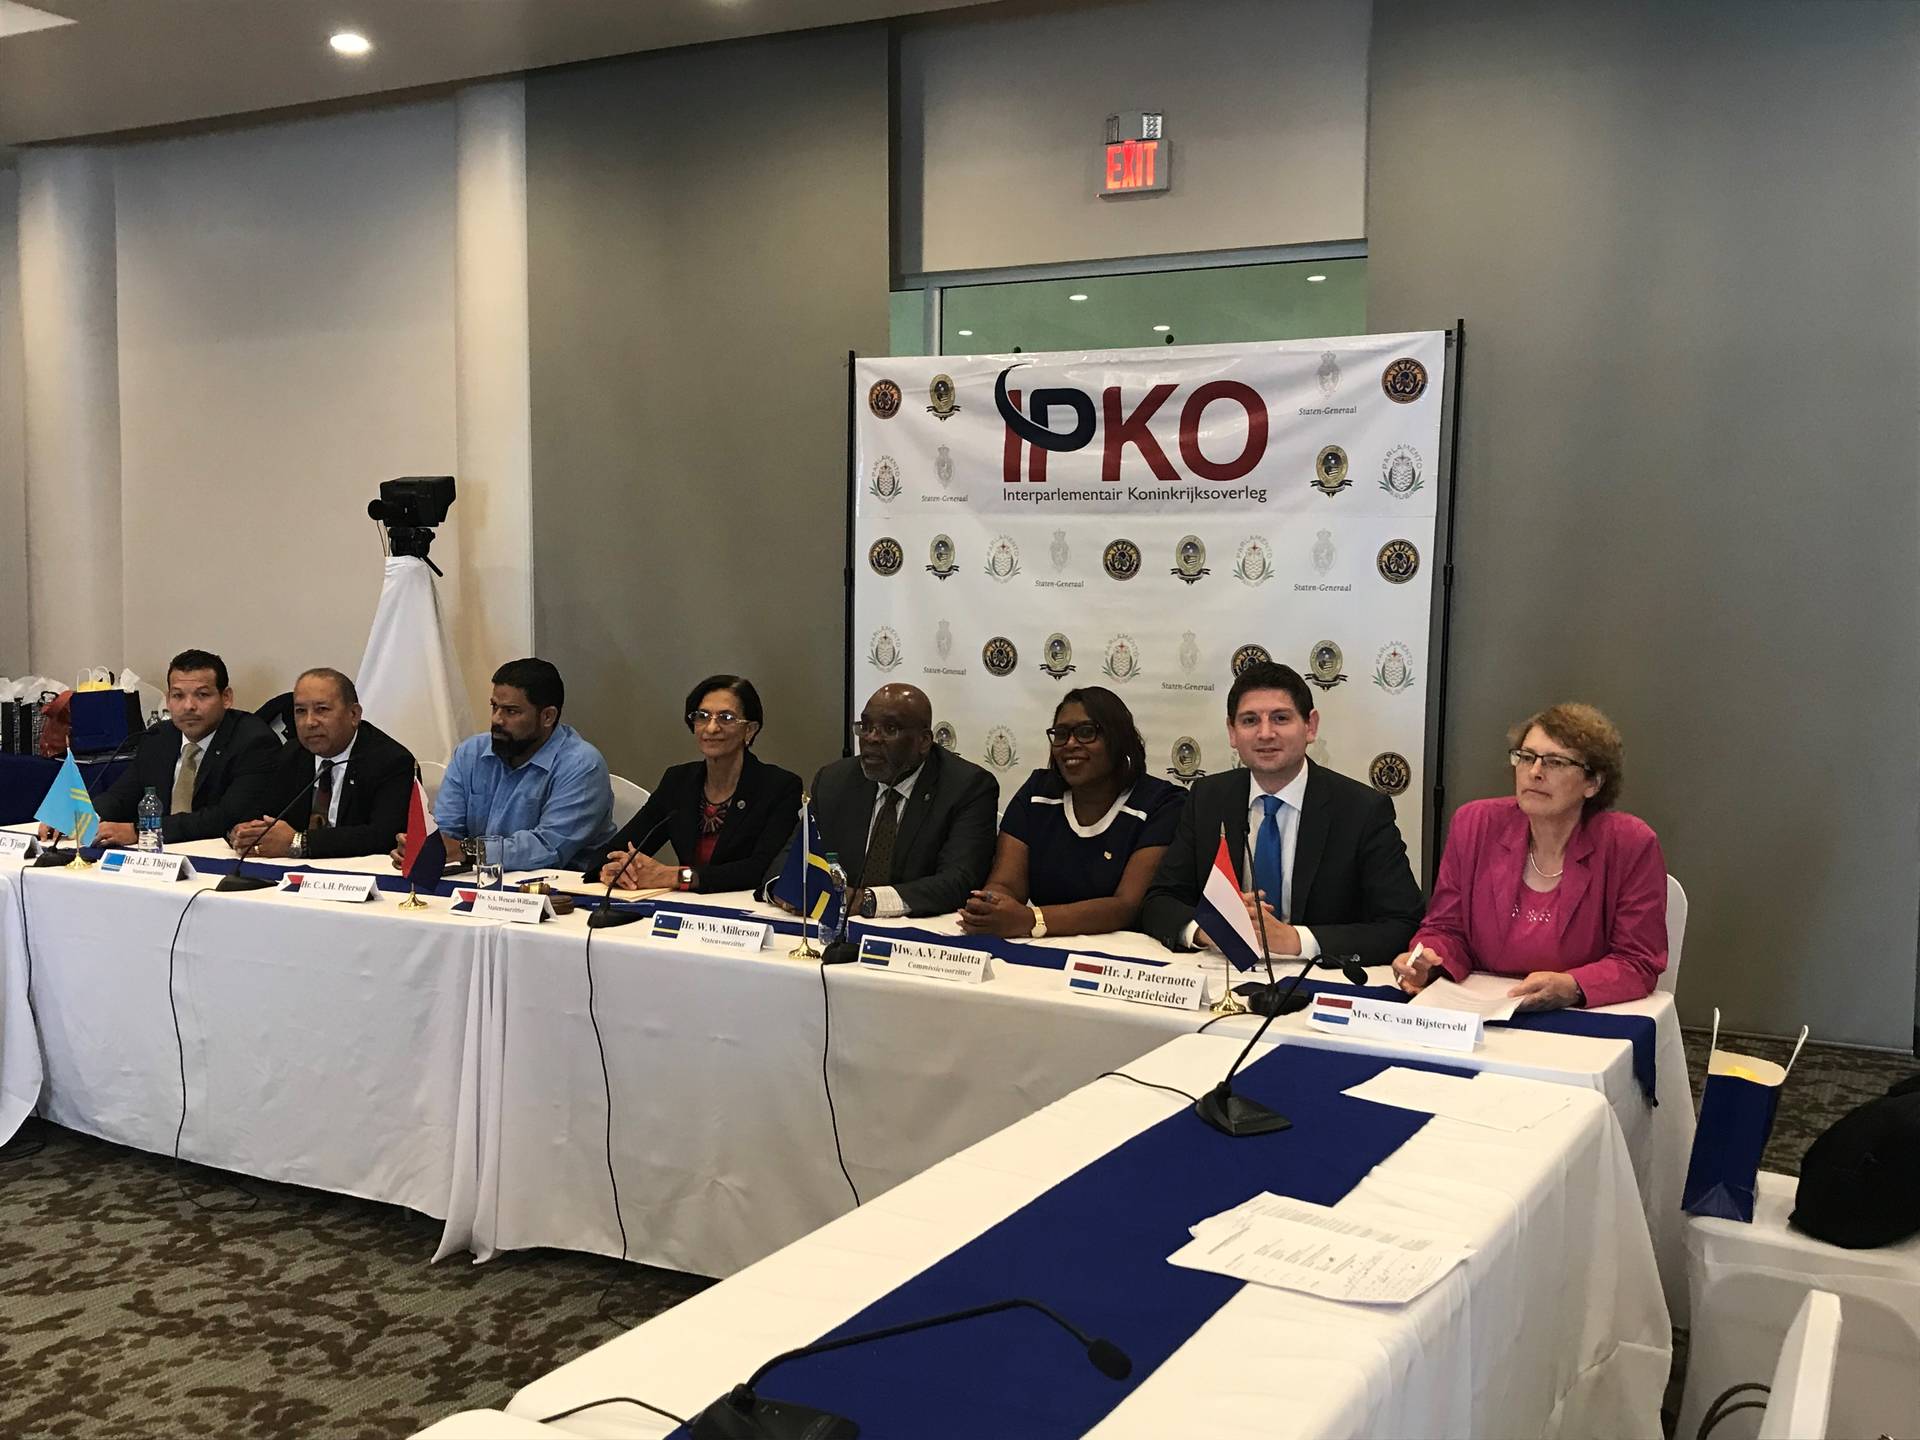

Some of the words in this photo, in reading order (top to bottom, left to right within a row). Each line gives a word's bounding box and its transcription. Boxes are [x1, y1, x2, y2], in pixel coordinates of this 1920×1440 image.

[1105, 141, 1158, 189] EXIT
[1298, 405, 1358, 416] Staten-Generaal
[995, 364, 1269, 482] IPKO
[1003, 487, 1123, 504] Interparlementair
[1128, 485, 1267, 503] Koninkrijksoverleg
[1293, 583, 1352, 592] Staten-Generaal
[1161, 682, 1215, 691] Staten-Generaal
[301, 880, 312, 888] Hr.
[338, 883, 367, 892] Peterson
[681, 920, 694, 930] Hr.
[697, 922, 719, 933] W.W.
[720, 924, 760, 937] Millerson
[892, 943, 913, 956] Mw.
[918, 947, 936, 959] A.V.
[940, 950, 981, 965] Pauletta
[1103, 965, 1120, 977] Hr.
[1122, 968, 1133, 980] J.
[1137, 970, 1197, 988] Paternotte
[1103, 983, 1188, 1005] Delegatieleider
[1352, 1009, 1371, 1020] Mw.
[1374, 1013, 1393, 1023] S.C.
[1396, 1017, 1412, 1025] van
[1415, 1016, 1467, 1032] Bijsterveld
